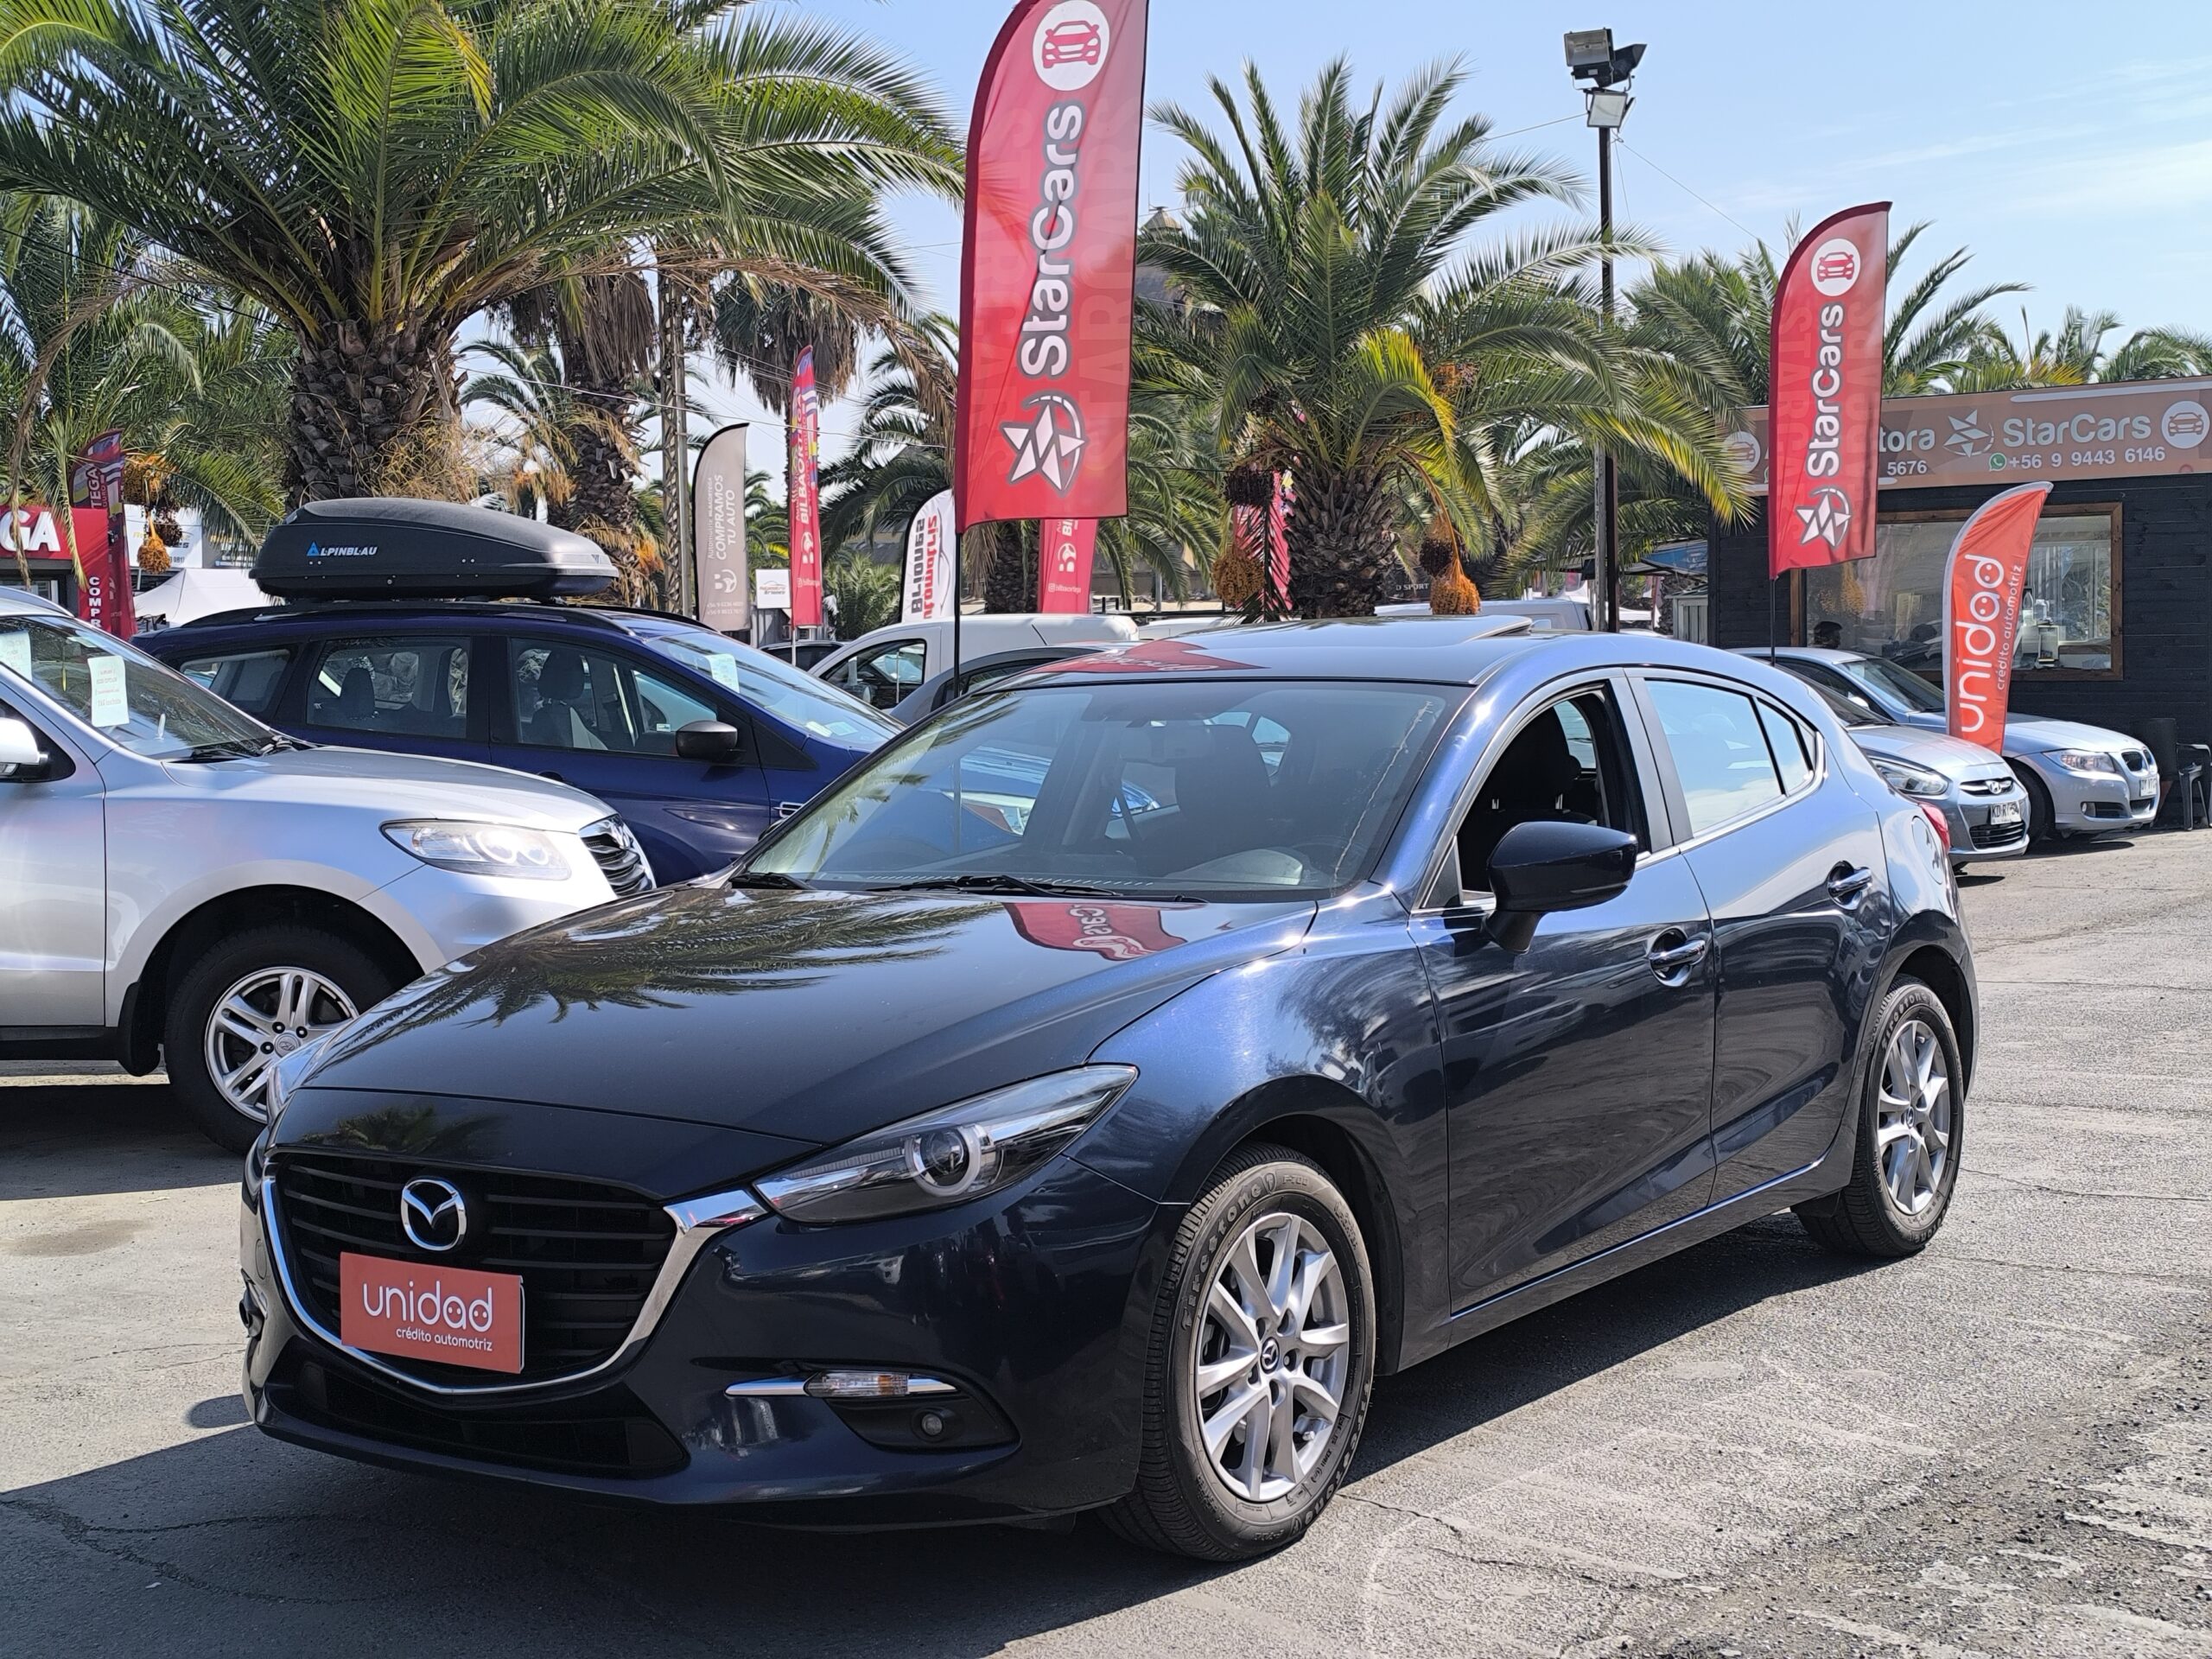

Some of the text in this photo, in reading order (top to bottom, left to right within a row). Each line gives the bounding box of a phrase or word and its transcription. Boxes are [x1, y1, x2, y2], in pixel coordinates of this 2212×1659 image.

[1020, 103, 1084, 377] StarCars
[1808, 304, 1844, 477] StarCars
[2003, 414, 2152, 448] StarCars
[1887, 461, 1927, 475] 5676
[2009, 447, 2165, 469] +56 9 9443 6146
[714, 474, 727, 561] COMPRAMOS
[726, 490, 736, 545] TU AUTO
[307, 541, 378, 556] ALPINBLAU
[1955, 554, 2005, 733] unidad
[1997, 564, 2023, 690] crédito automotriz
[363, 1281, 493, 1332] unidad
[397, 1326, 493, 1352] crédito automotriz
